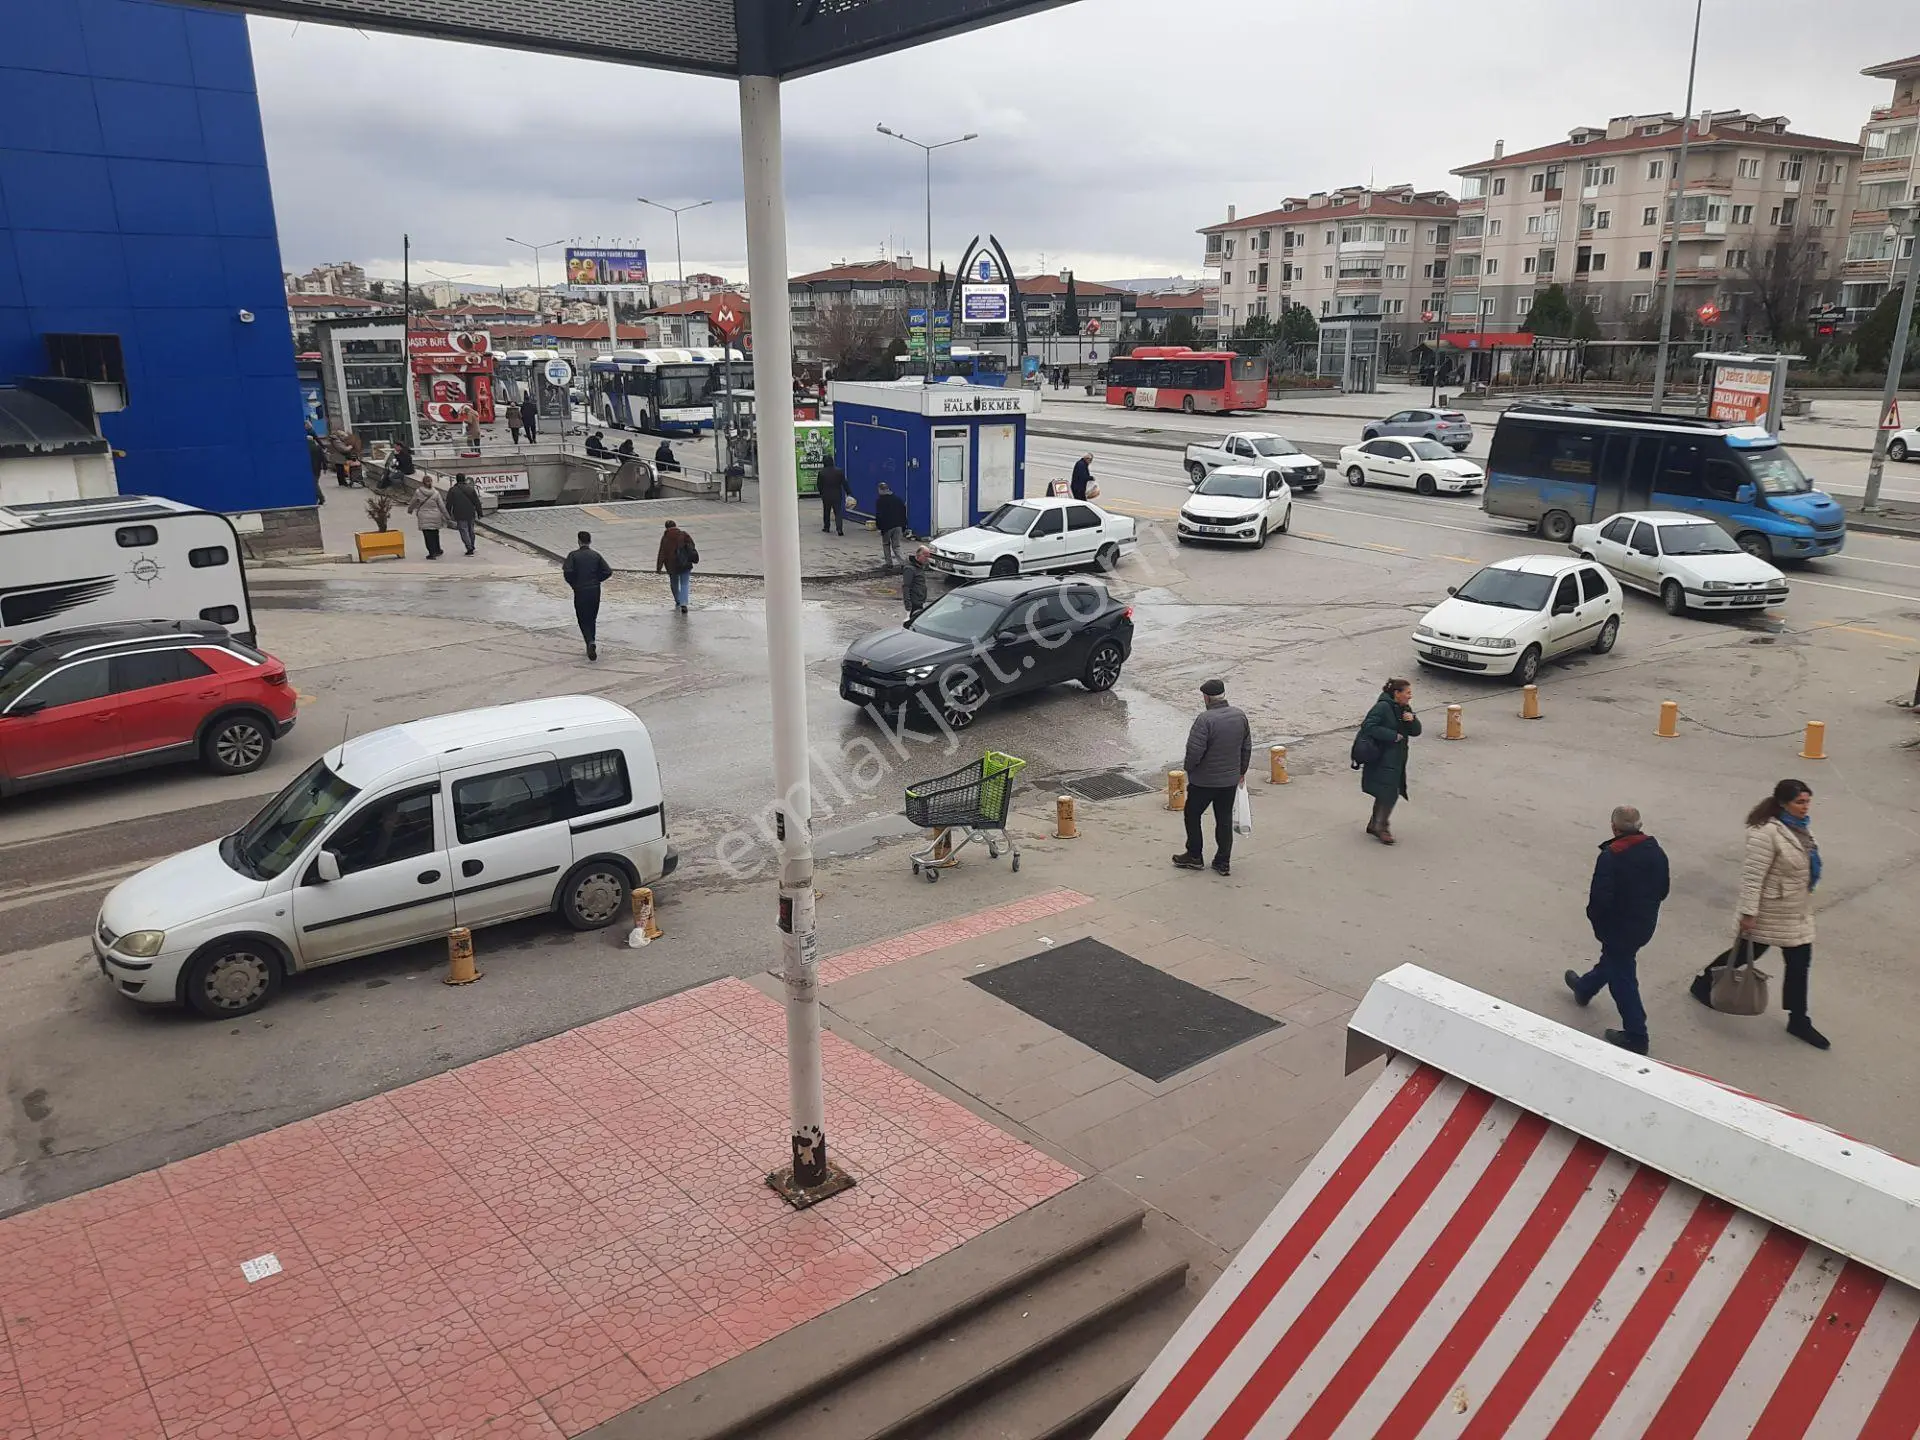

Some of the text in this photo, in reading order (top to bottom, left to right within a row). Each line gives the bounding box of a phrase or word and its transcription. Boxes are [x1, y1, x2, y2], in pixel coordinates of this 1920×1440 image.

[717, 310, 734, 322] M
[944, 400, 1021, 412] HALK EKMEK
[474, 474, 519, 485] ATIKENT
